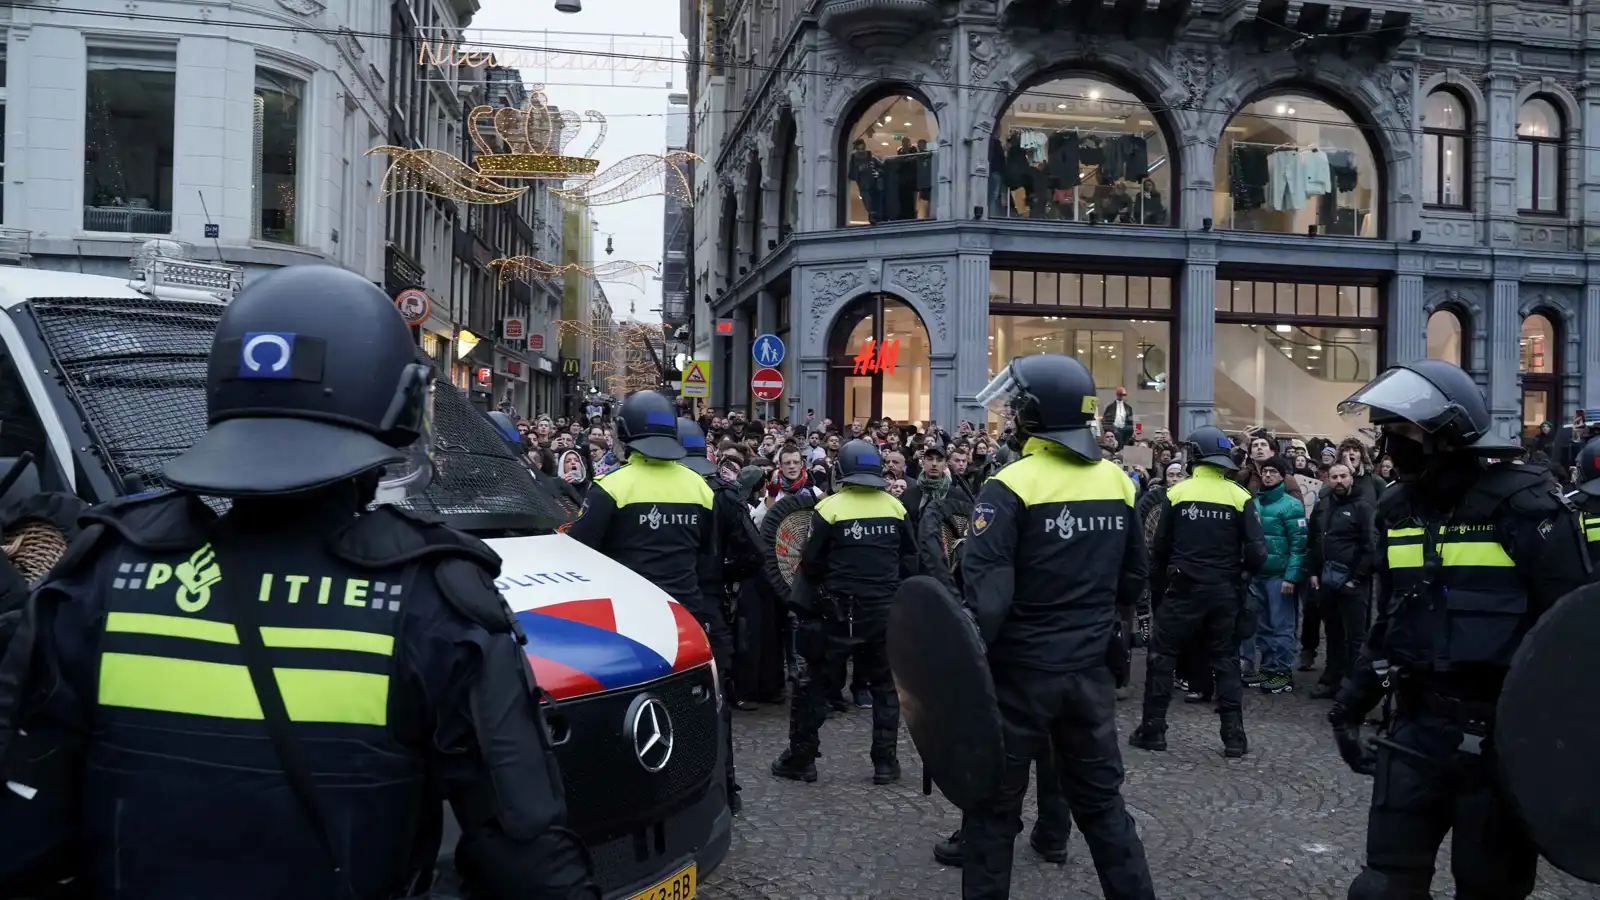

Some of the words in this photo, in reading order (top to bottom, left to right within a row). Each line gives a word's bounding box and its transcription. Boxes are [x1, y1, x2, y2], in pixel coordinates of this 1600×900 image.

[853, 340, 900, 376] H&M
[146, 543, 370, 612] POITIE
[493, 571, 591, 591] OLITIE
